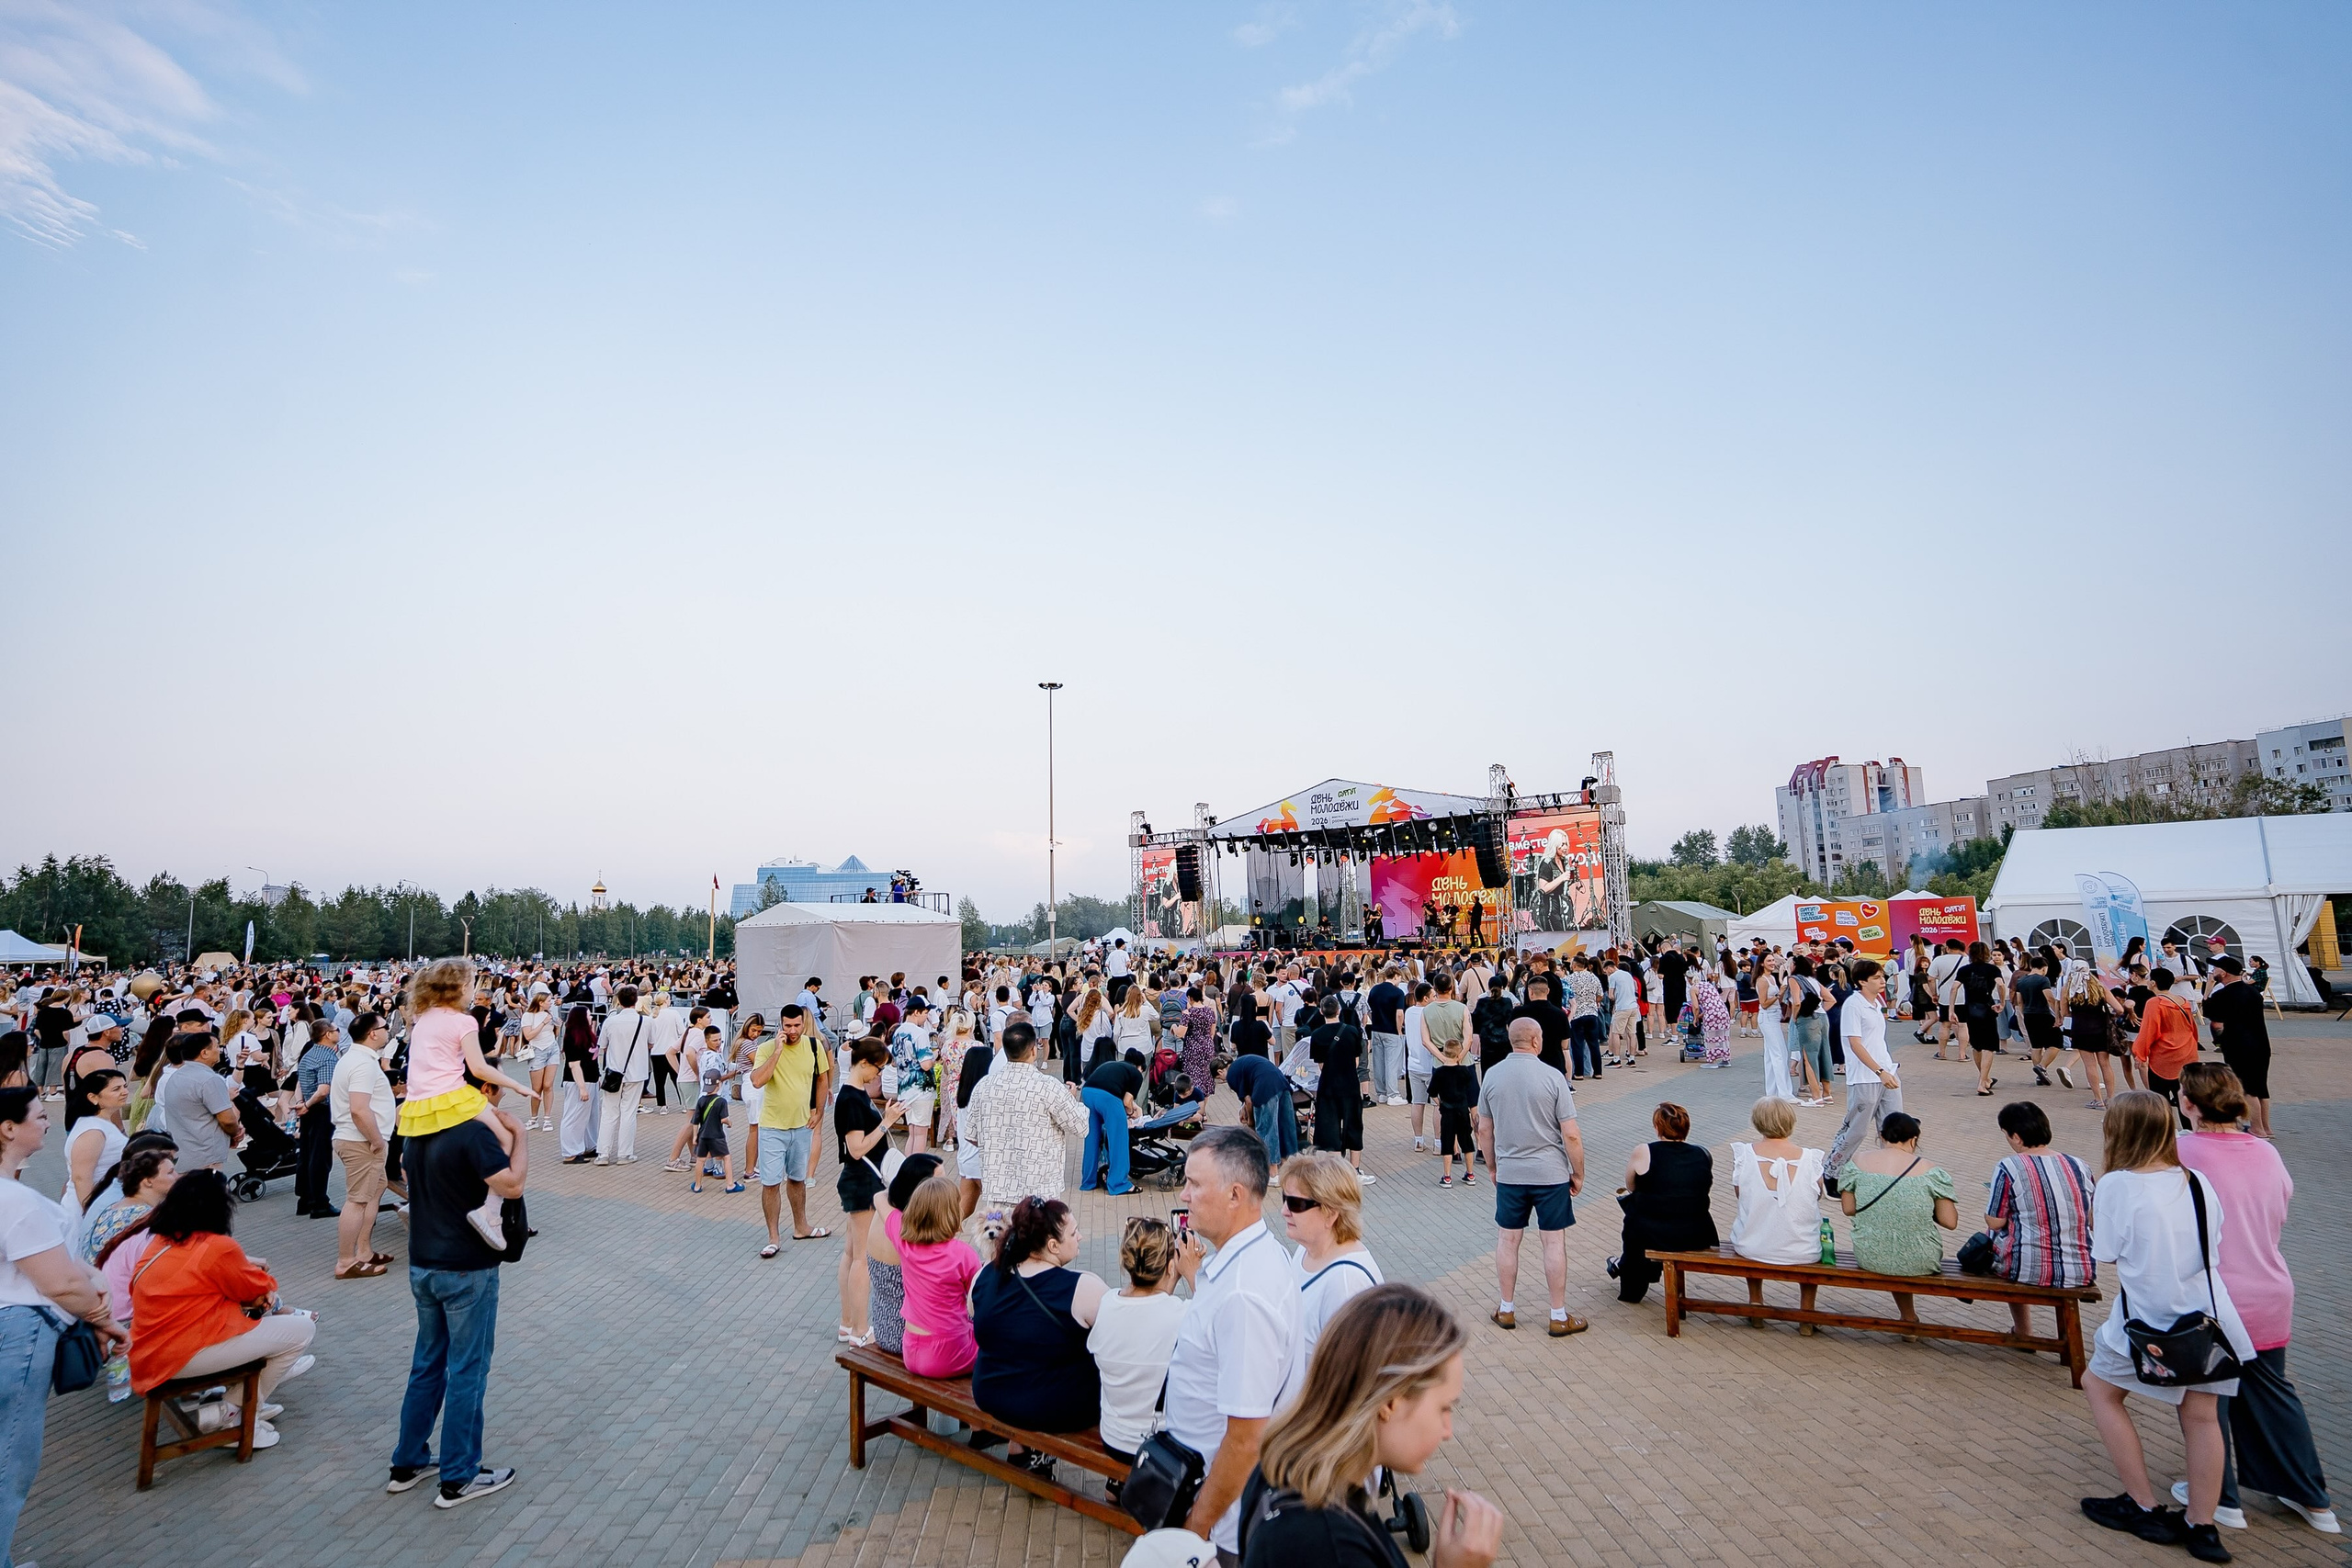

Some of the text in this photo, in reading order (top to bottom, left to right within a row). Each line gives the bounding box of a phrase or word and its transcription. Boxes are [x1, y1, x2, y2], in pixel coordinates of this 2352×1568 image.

[1338, 787, 1357, 797] СУРГУТ
[1311, 793, 1333, 804] ДЕНЬ
[1311, 799, 1359, 814] МОЛОДЁЖИ
[1311, 817, 1329, 826] 2026
[1431, 875, 1468, 891] ДЕНЬ
[1919, 908, 1941, 916] ДЕНЬ
[1944, 905, 1966, 913] СУРГУТ
[1919, 914, 1966, 924] МОЛОДЁЖИ
